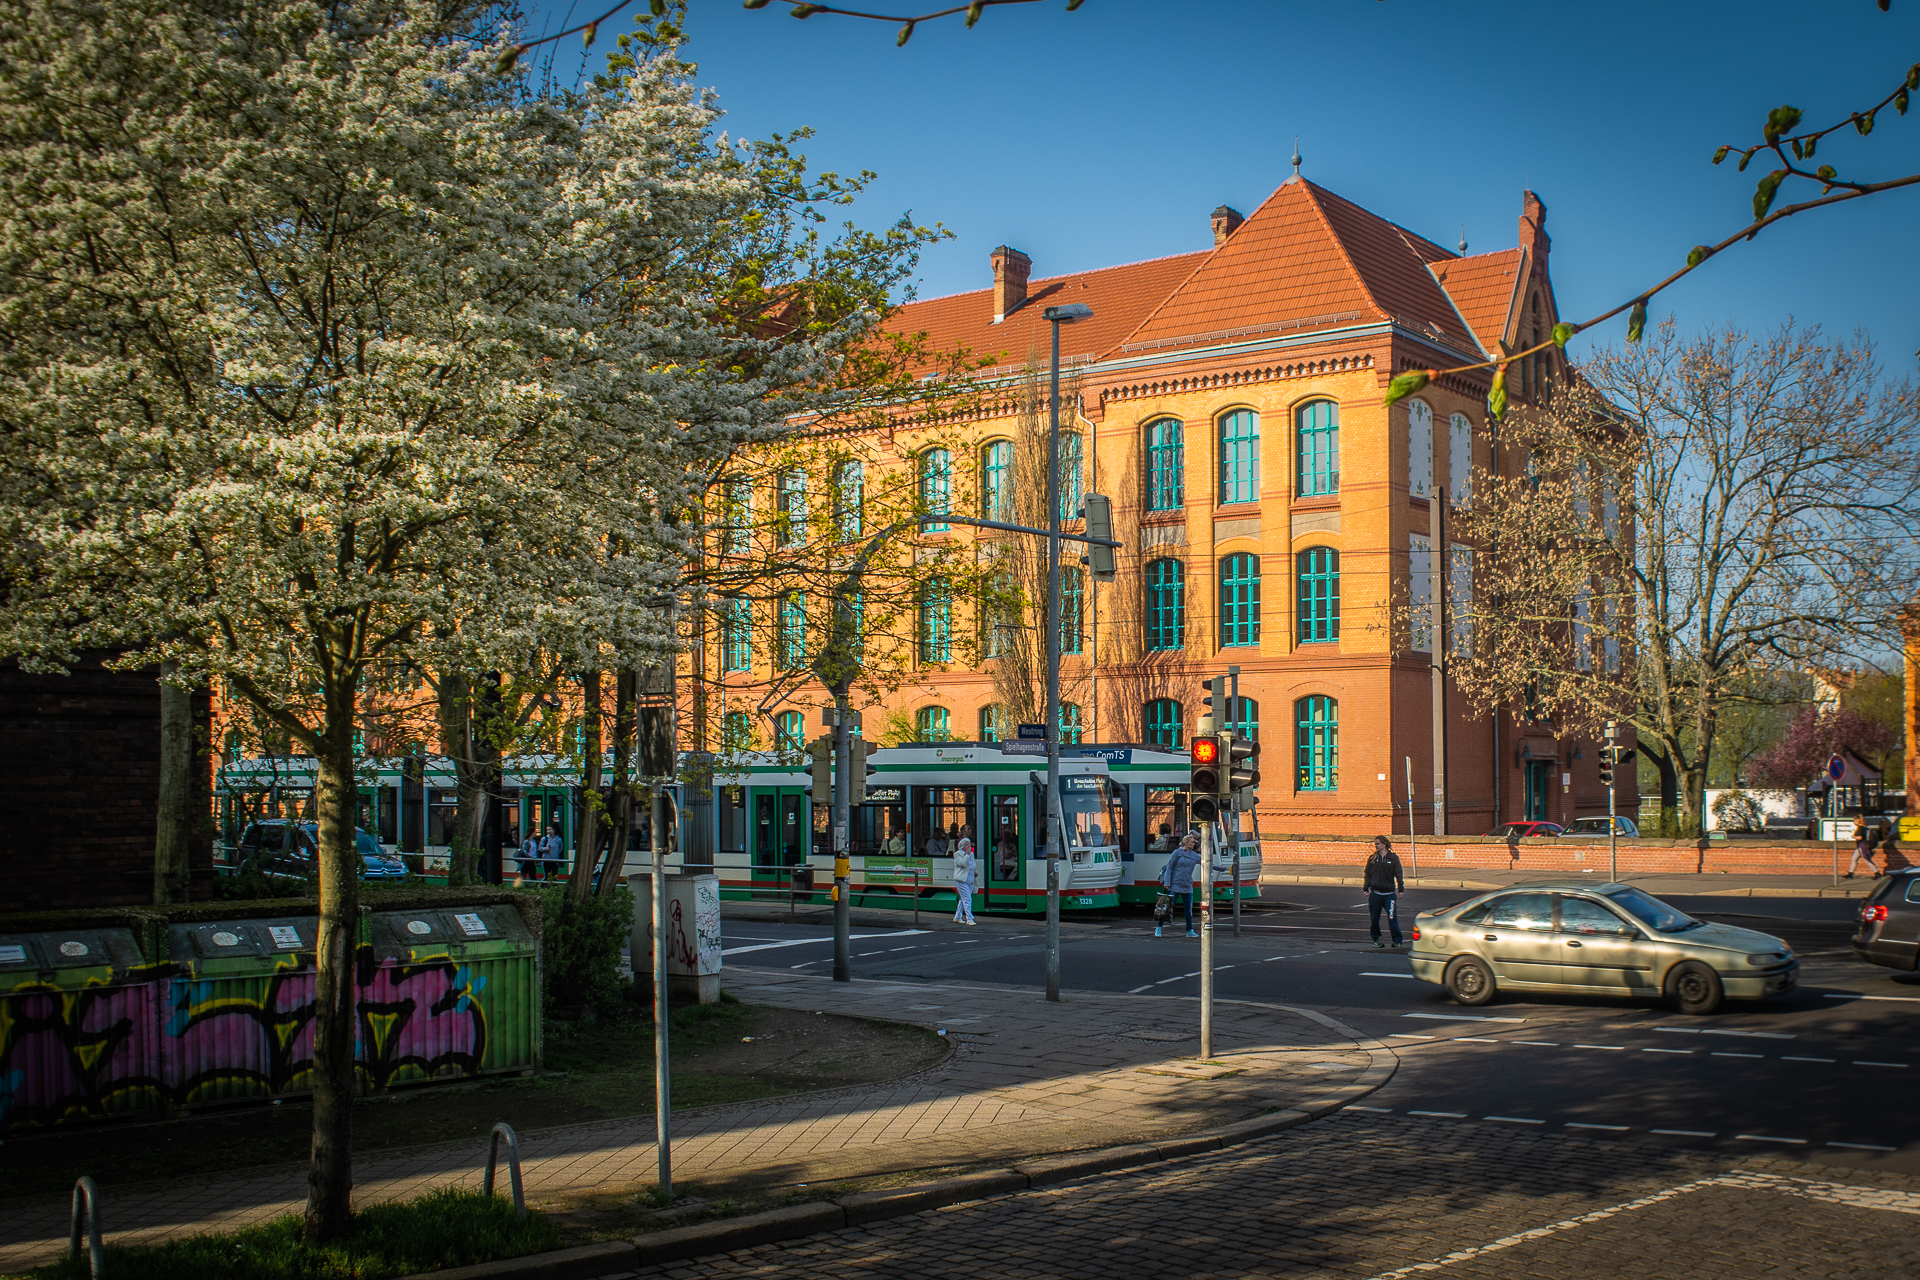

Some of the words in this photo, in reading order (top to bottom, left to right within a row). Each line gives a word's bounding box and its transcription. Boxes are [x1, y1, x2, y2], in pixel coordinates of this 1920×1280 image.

[1020, 726, 1044, 738] Westring
[1005, 741, 1045, 753] Spielhagenstraße
[1096, 750, 1125, 760] ComTS
[1067, 778, 1072, 789] 1
[1079, 897, 1093, 905] 1328
